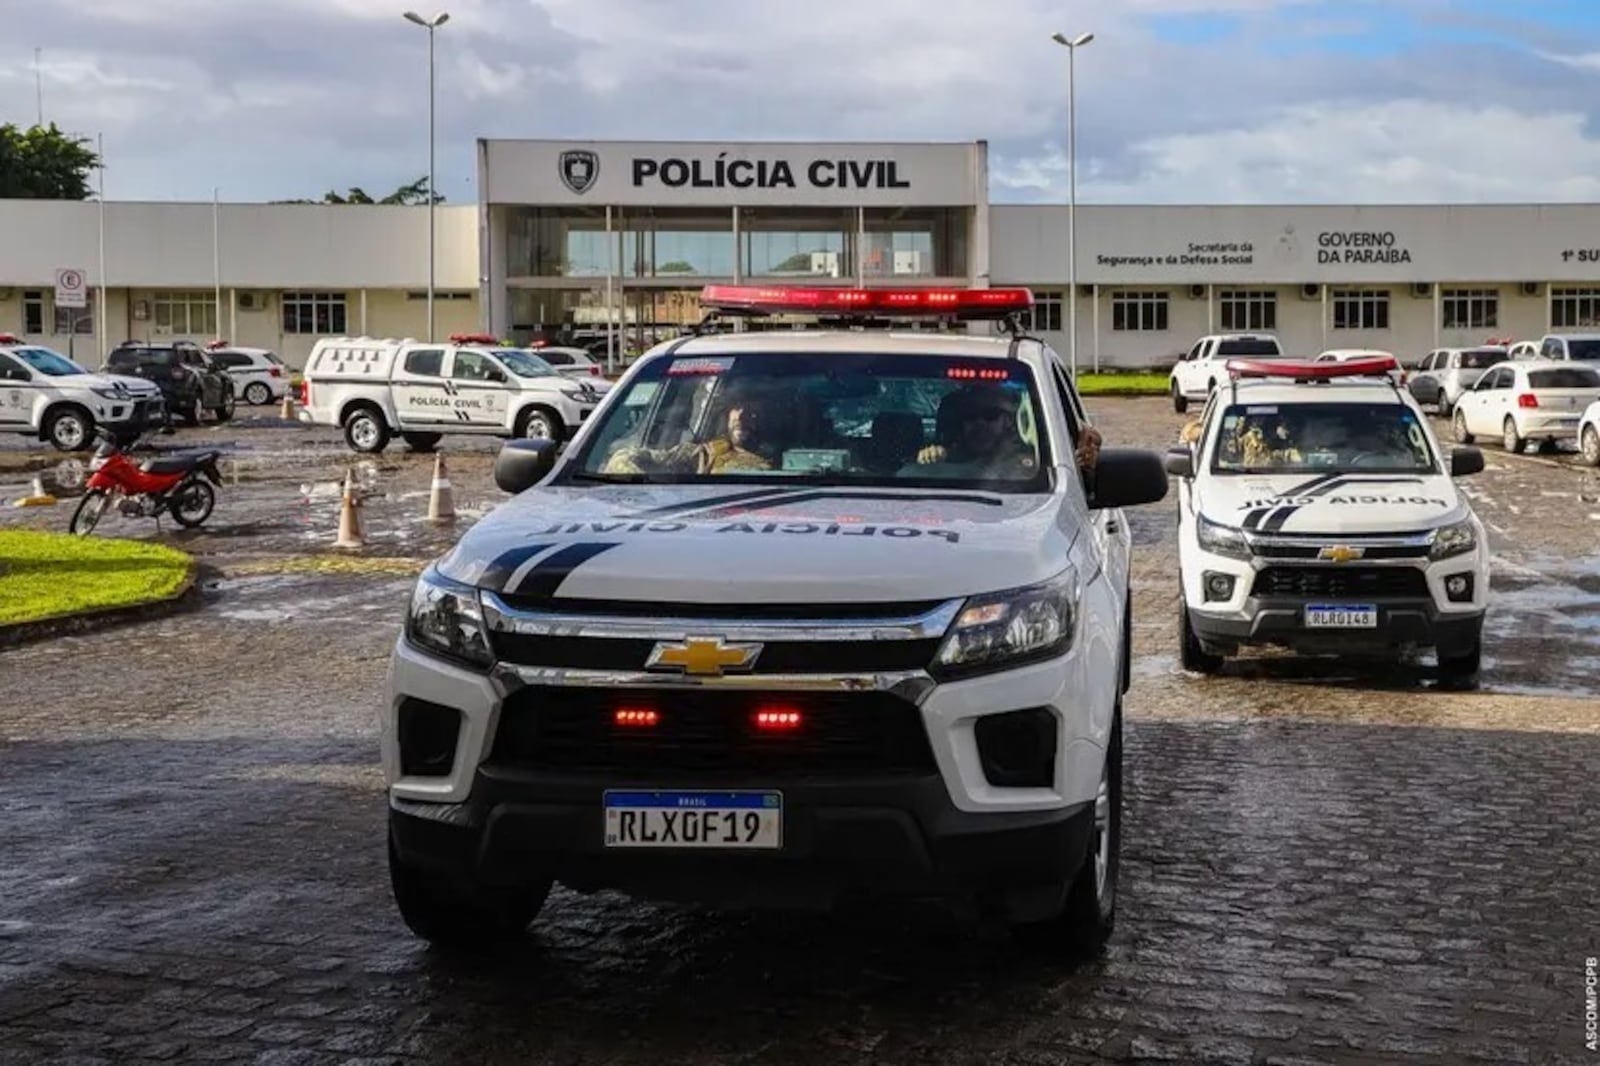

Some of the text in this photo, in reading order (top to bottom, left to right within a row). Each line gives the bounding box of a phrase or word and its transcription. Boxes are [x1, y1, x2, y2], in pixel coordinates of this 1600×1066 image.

[632, 152, 910, 188] POLÍCIA CIVIL
[1318, 231, 1395, 247] GOVERNO
[1188, 242, 1253, 253] Secretaria da
[1318, 246, 1411, 263] DA PARAÍBA
[1097, 255, 1153, 267] Segurança
[1165, 255, 1178, 265] da
[1180, 255, 1218, 265] Defesa
[1221, 255, 1253, 265] Social
[454, 399, 481, 408] CIVIL
